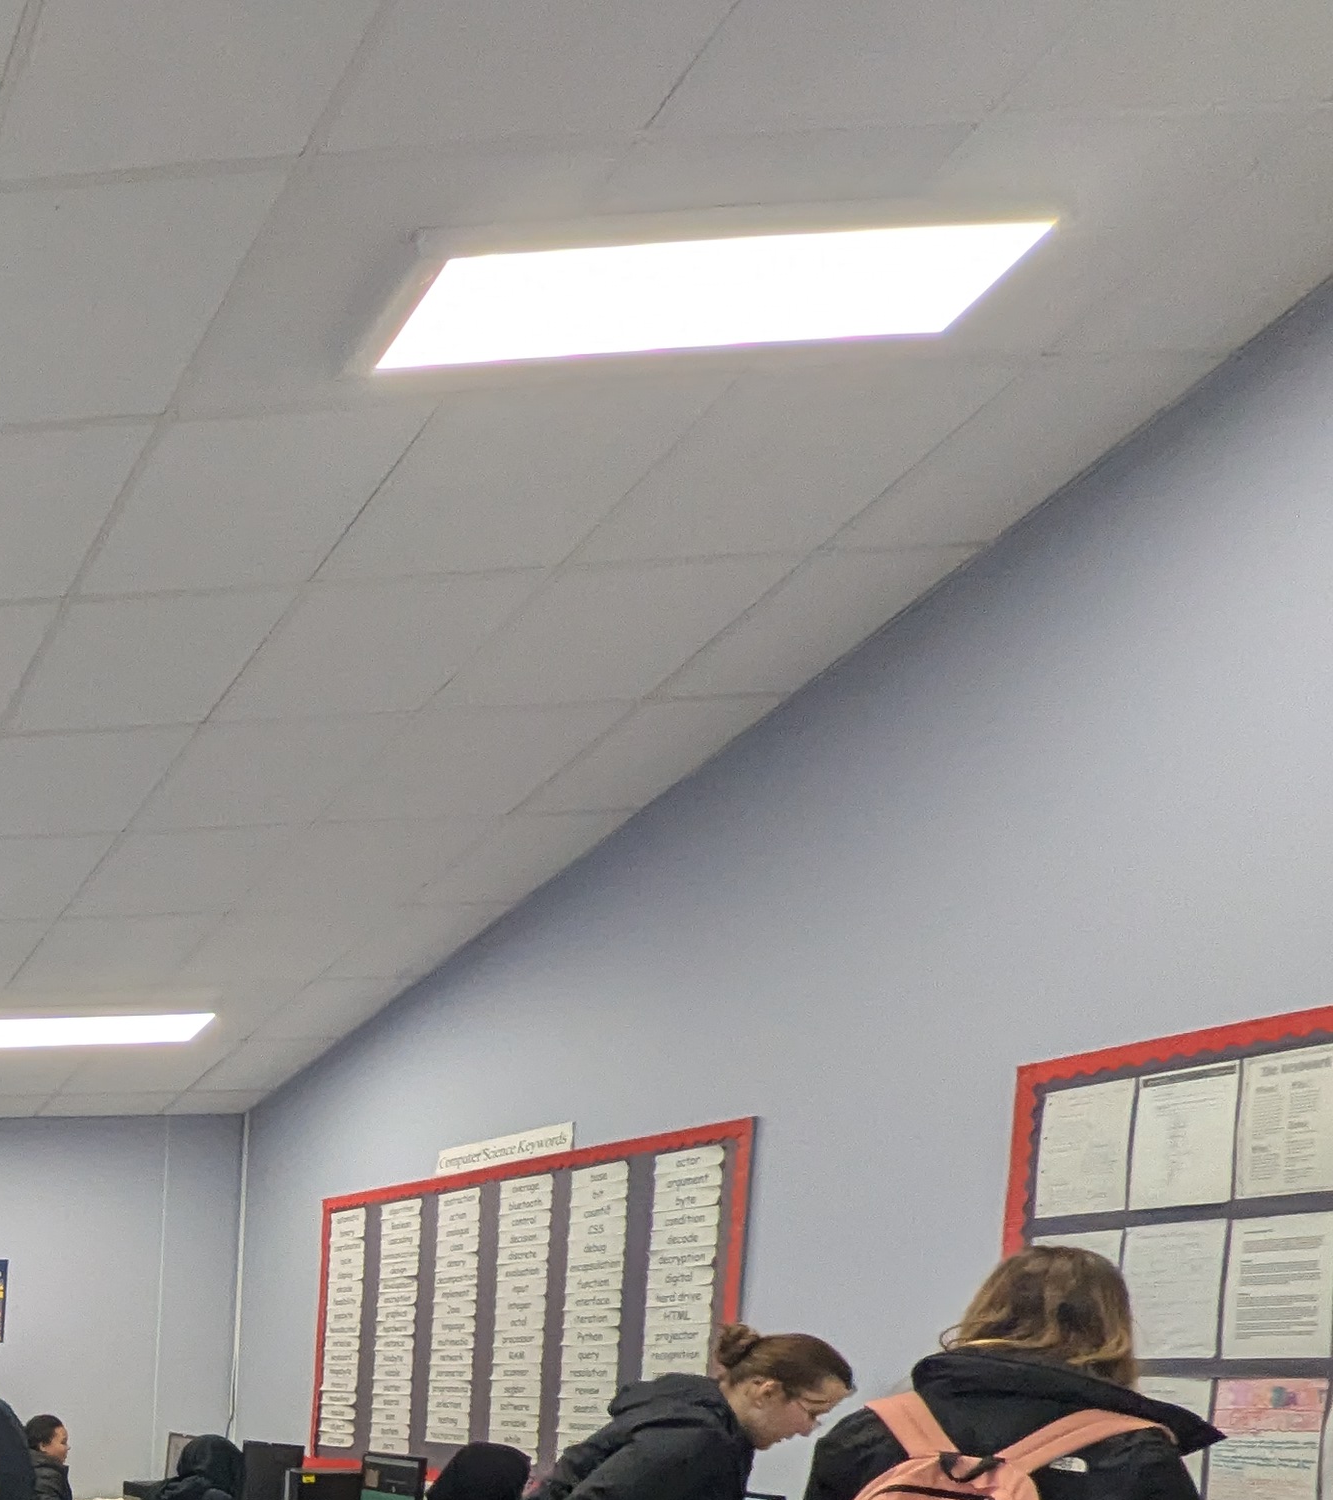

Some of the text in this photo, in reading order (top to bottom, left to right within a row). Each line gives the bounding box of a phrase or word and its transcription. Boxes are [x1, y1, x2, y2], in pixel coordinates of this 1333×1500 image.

[438, 1132, 567, 1169] Computer Science Keywords
[676, 1156, 701, 1168] actor
[667, 1174, 709, 1192] argument
[675, 1195, 697, 1207] byte
[665, 1214, 705, 1227] condition
[666, 1234, 699, 1245] decode
[658, 1253, 705, 1266] decryption
[665, 1272, 693, 1286] digital
[678, 1292, 702, 1302] drive
[663, 1310, 691, 1320] HTML
[654, 1331, 699, 1343] projector
[577, 1352, 599, 1362] query
[651, 1351, 700, 1363] recognition
